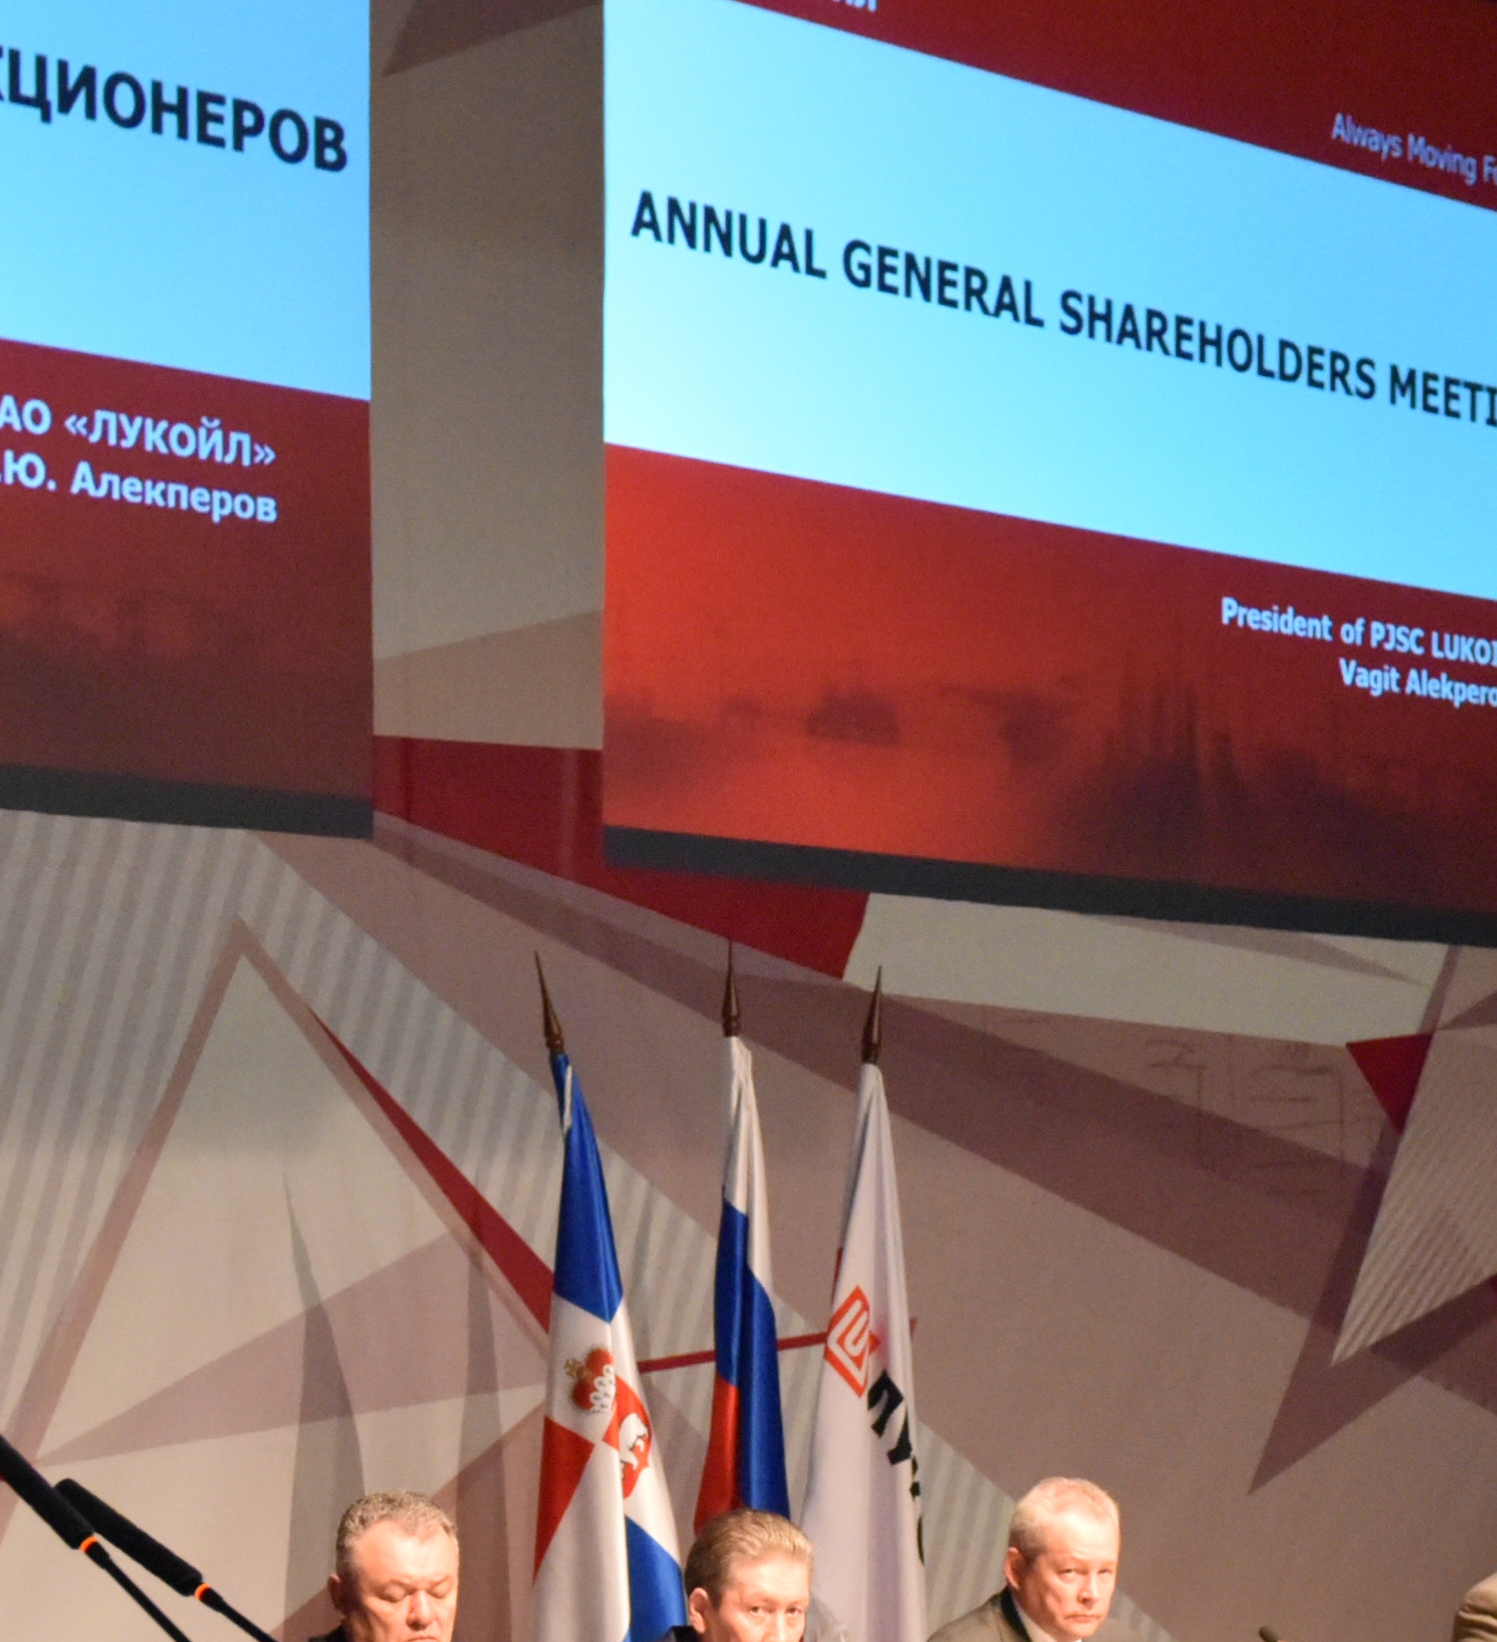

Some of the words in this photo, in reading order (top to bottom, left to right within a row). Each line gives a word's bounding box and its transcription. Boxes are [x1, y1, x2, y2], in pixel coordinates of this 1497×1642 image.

[1332, 111, 1402, 160] Always
[1407, 134, 1476, 185] Moving
[631, 190, 826, 279] ANNUAL
[843, 240, 1044, 328] GENERAL
[1058, 290, 1377, 400] SHAREHOLDERS
[64, 409, 277, 469] «ЛУКОЙЛ»
[71, 463, 277, 525] Алекперов
[1221, 597, 1332, 643] President
[1340, 617, 1366, 647] of
[1370, 621, 1424, 657] PJSC
[1339, 658, 1399, 697] Vagit
